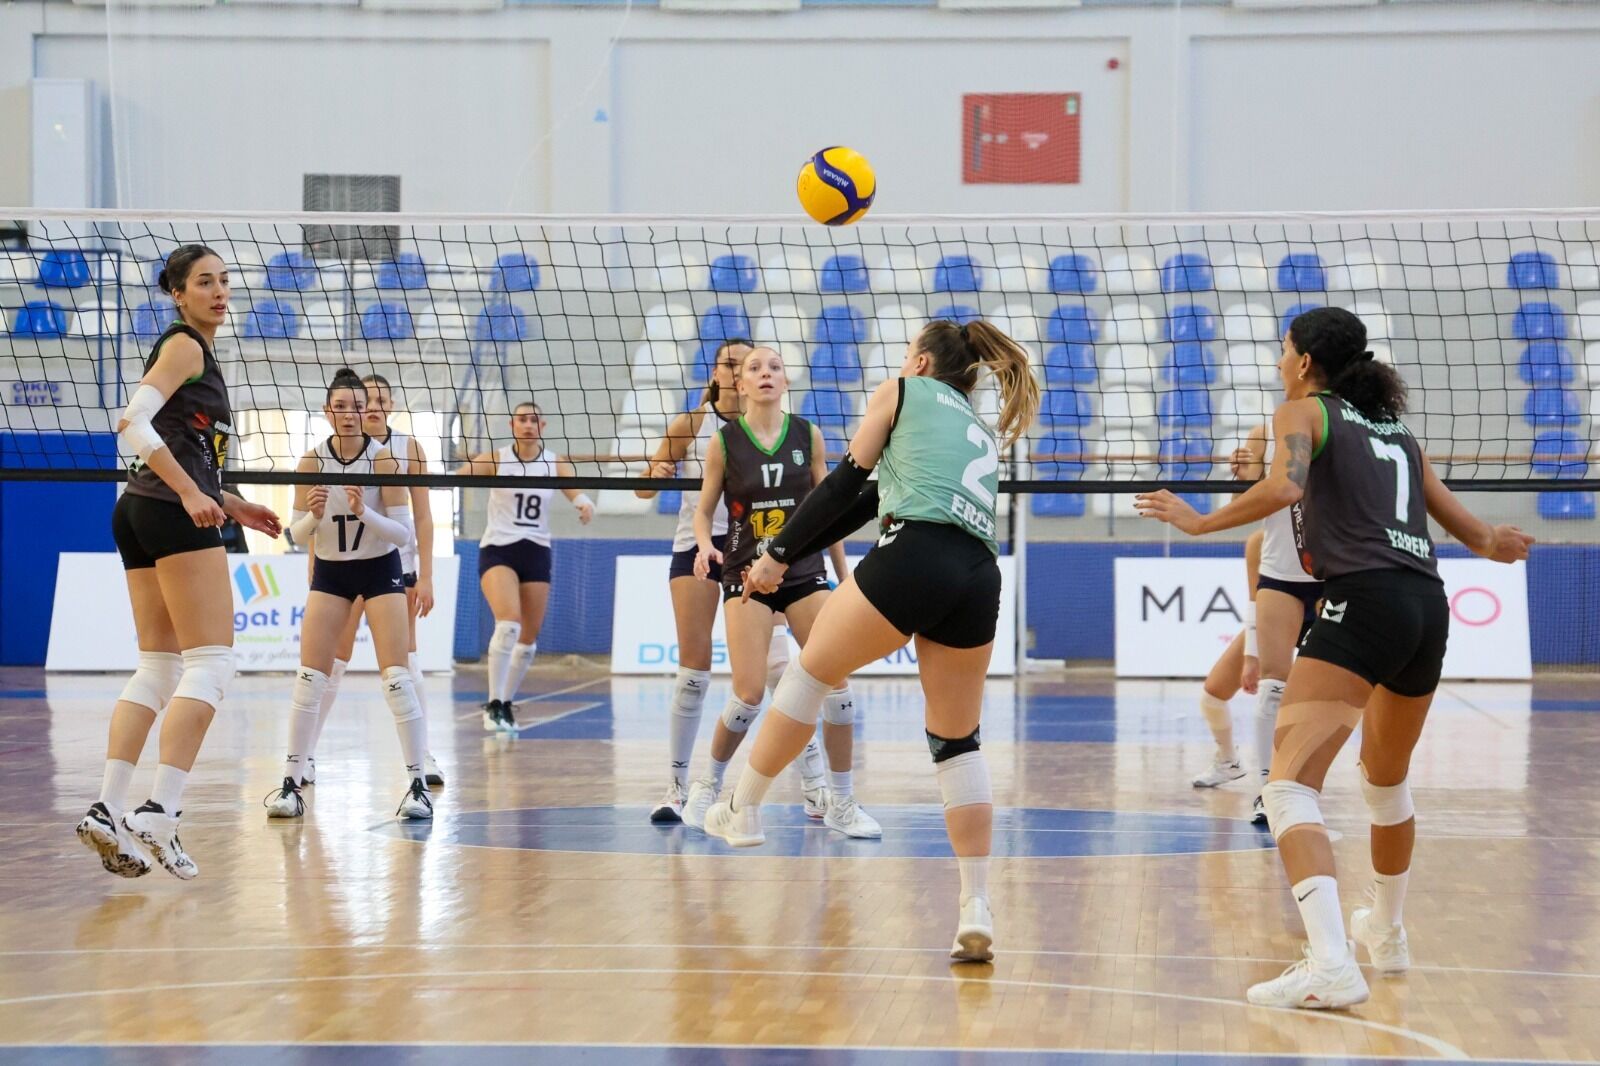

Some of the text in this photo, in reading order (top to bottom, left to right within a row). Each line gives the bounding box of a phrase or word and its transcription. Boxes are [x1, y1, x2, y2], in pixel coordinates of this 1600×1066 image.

[760, 462, 784, 488] 17
[961, 423, 999, 510] 2
[1368, 437, 1410, 524] 7
[514, 493, 542, 520] 18
[332, 514, 365, 552] 17
[750, 509, 786, 538] 12
[1385, 528, 1430, 559] YAREN
